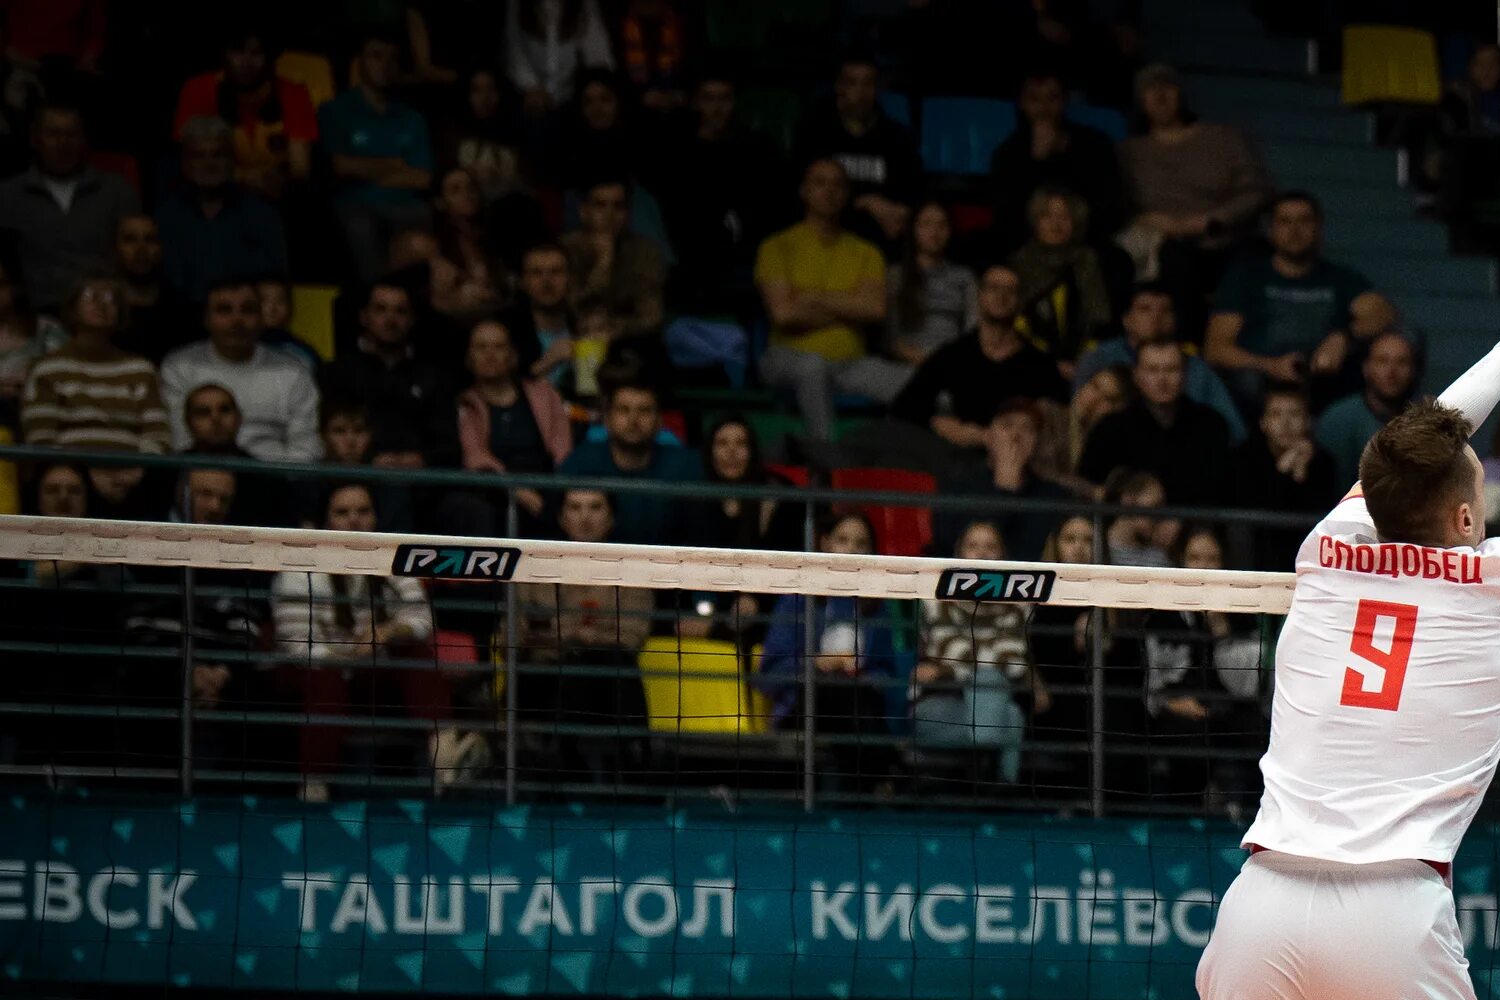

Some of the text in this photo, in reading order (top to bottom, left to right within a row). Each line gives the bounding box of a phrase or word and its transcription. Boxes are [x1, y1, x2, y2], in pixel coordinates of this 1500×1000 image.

[403, 548, 510, 576] PARI
[1319, 535, 1483, 584] СПОДОБЕЦ
[946, 572, 1046, 599] PARI
[1339, 598, 1419, 712] 9
[282, 872, 737, 937] ТАШТАГОЛ
[810, 869, 1219, 946] КИСЕЛЁВС
